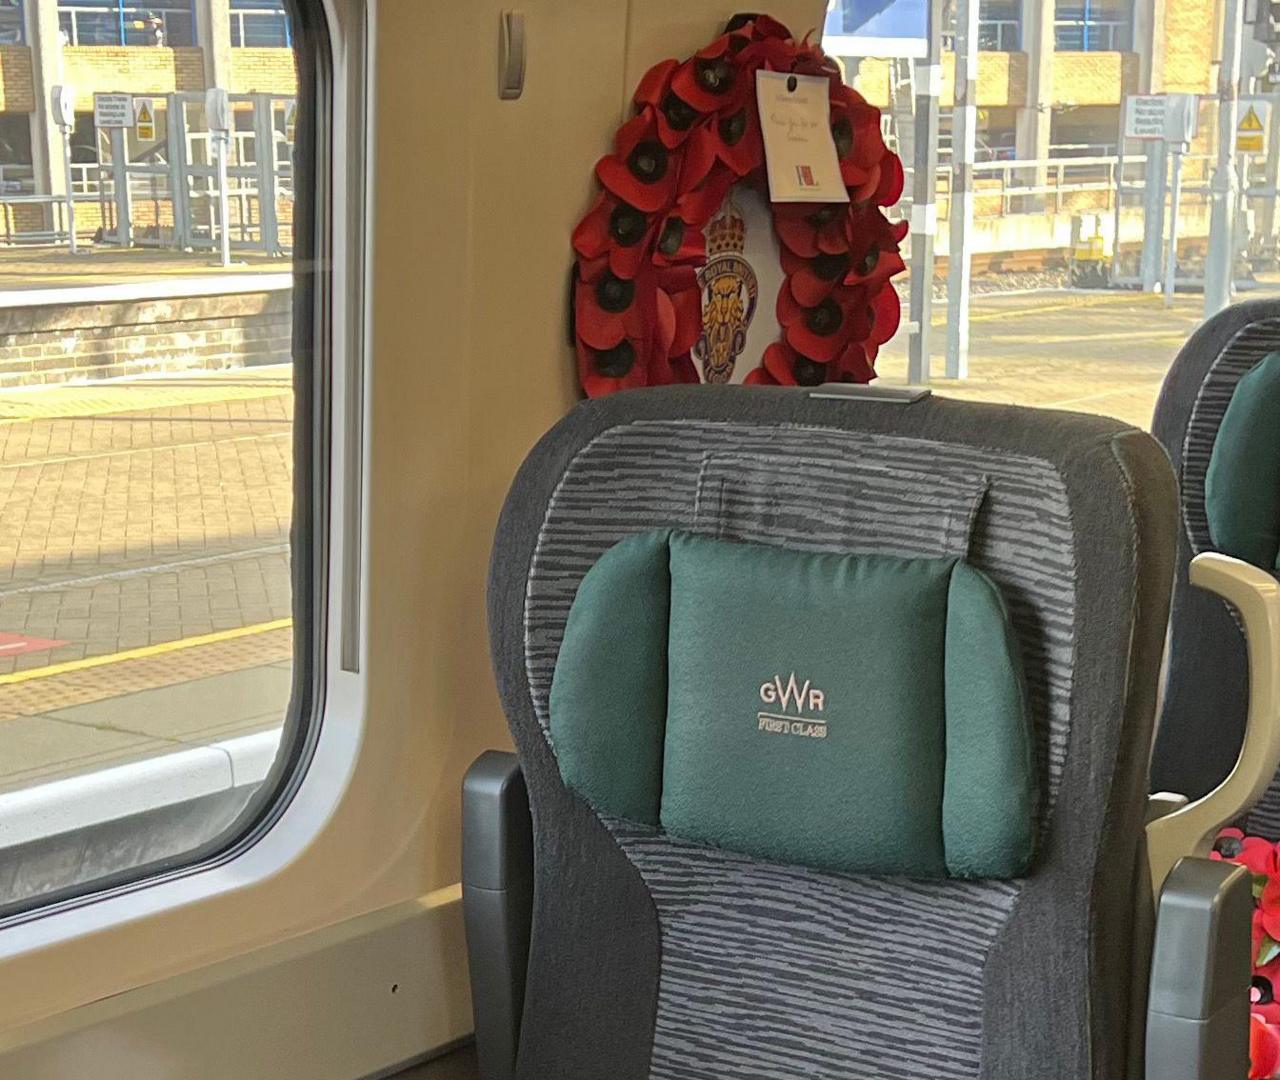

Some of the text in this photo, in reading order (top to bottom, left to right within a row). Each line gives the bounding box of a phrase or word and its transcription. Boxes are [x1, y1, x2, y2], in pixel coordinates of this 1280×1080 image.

[760, 671, 825, 714] GWR
[758, 717, 827, 738] FIRST CLASS
